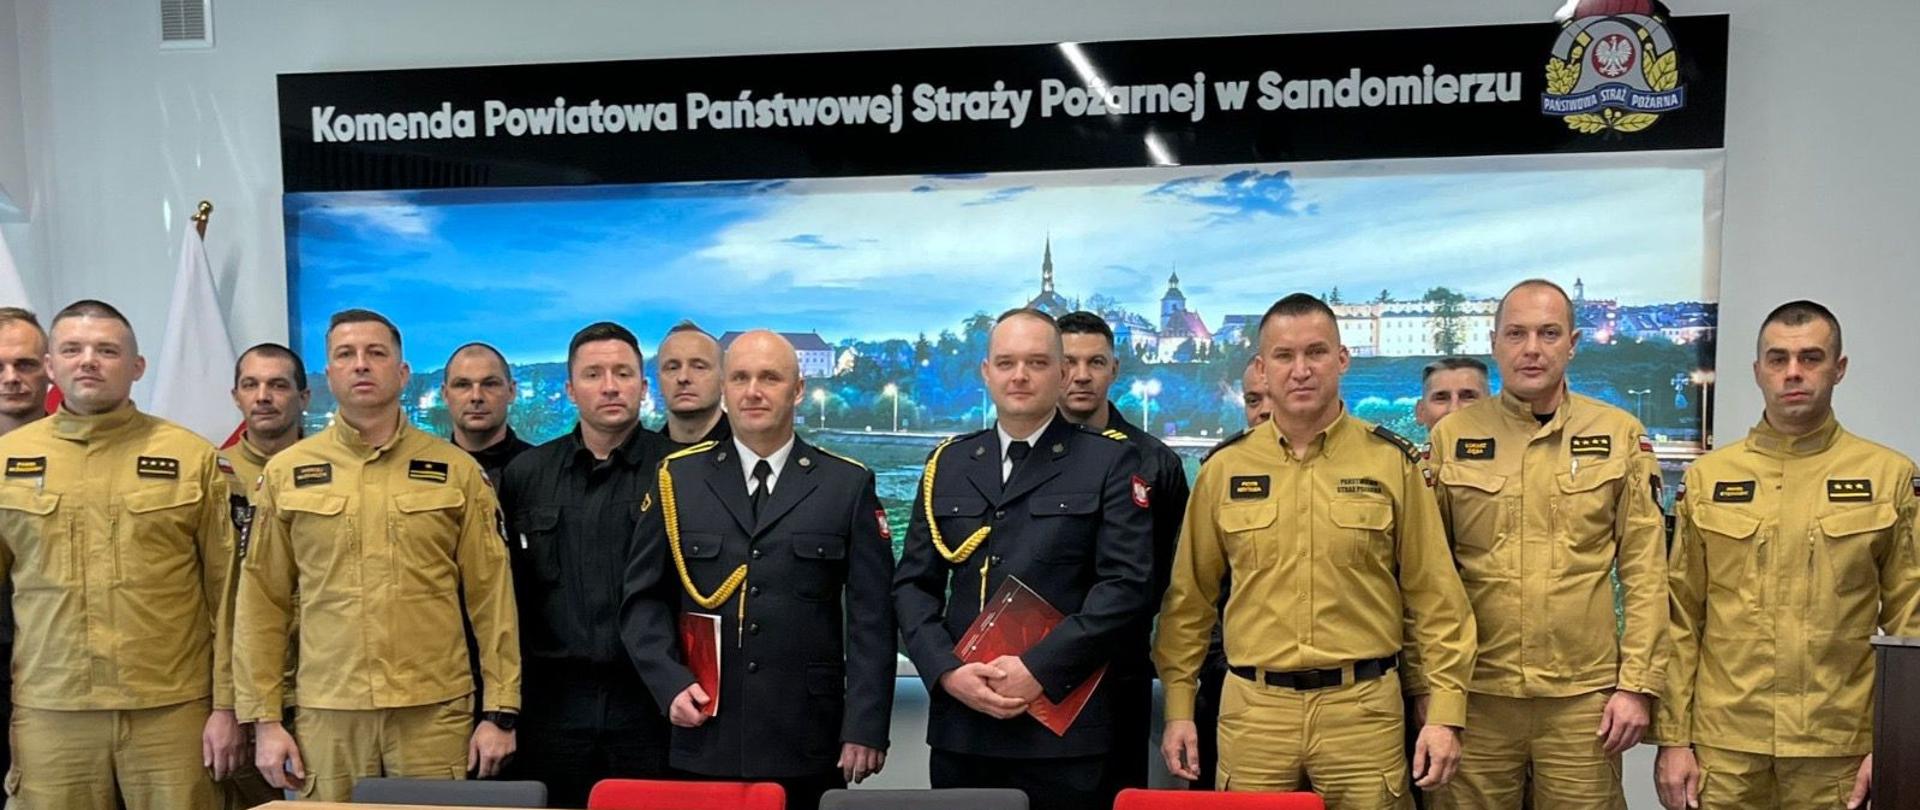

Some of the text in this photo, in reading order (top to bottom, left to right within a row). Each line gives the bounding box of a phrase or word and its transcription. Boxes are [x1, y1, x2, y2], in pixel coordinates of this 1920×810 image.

[312, 64, 1521, 142] Komenda Powiatowa Państwowej Straży Pożarnej w Sandomierzu
[1543, 88, 1678, 112] PAŃSTWOWA STRAŻ POŻARNA
